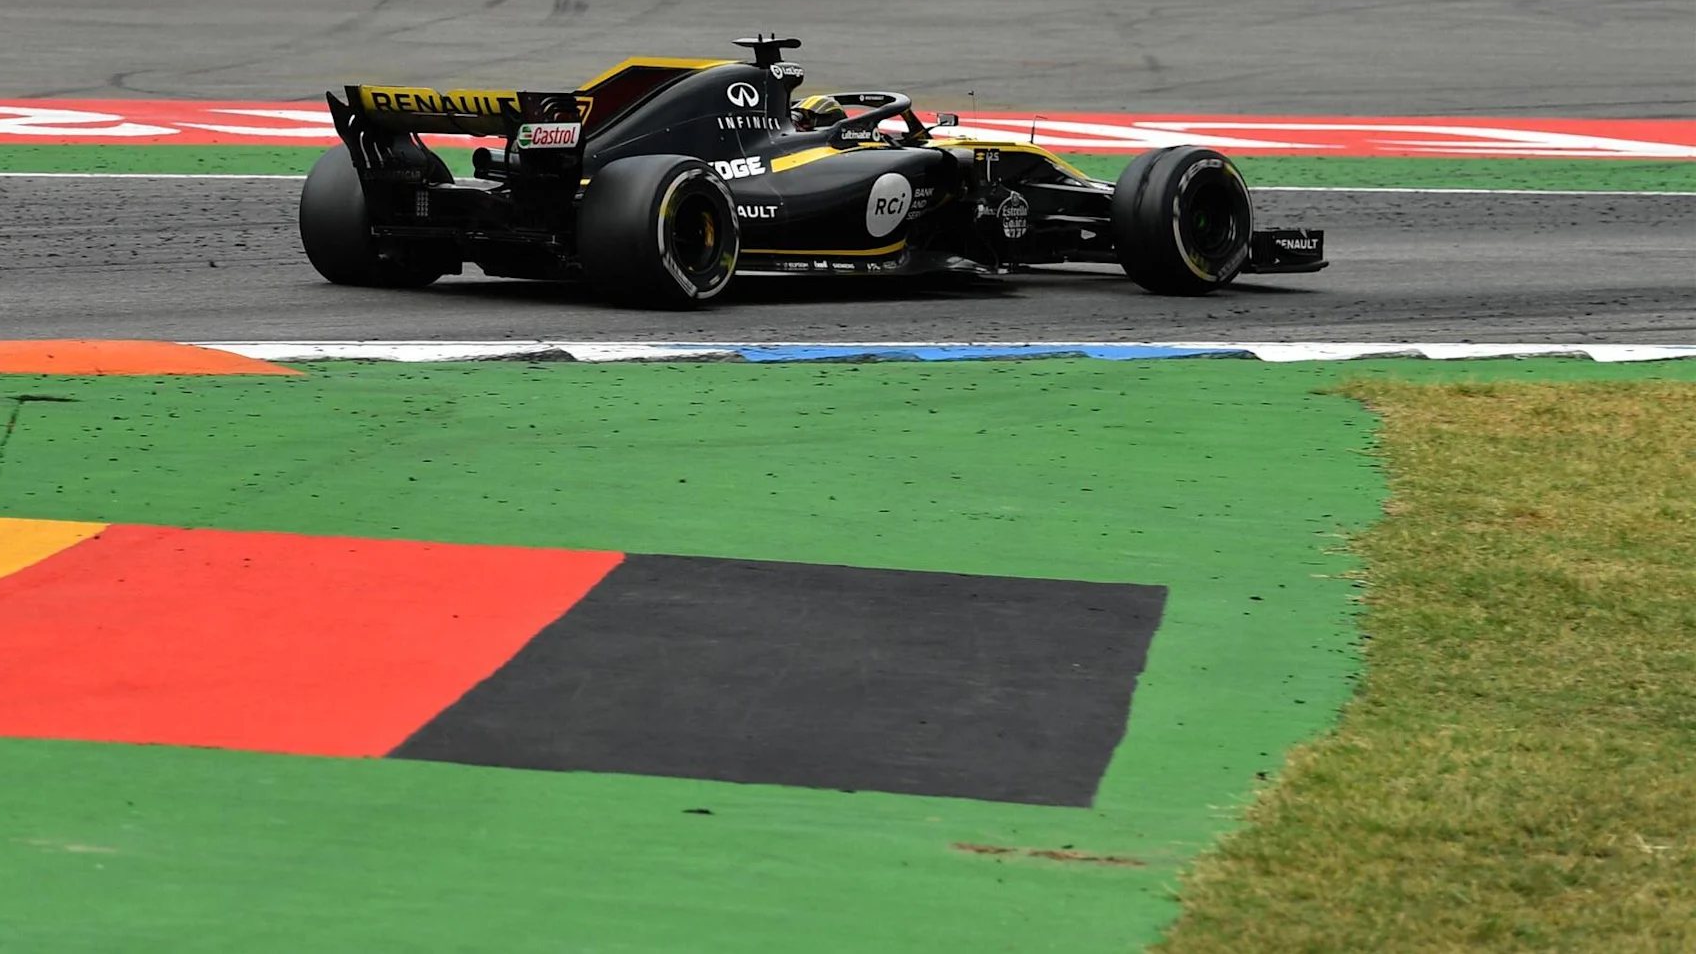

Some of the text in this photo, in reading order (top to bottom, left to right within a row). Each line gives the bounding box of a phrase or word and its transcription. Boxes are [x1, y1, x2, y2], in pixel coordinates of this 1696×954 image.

[371, 92, 517, 114] RENAULT
[532, 126, 577, 146] Castrol
[708, 155, 766, 181] DGE
[737, 205, 778, 218] AULT
[875, 192, 906, 215] RCi
